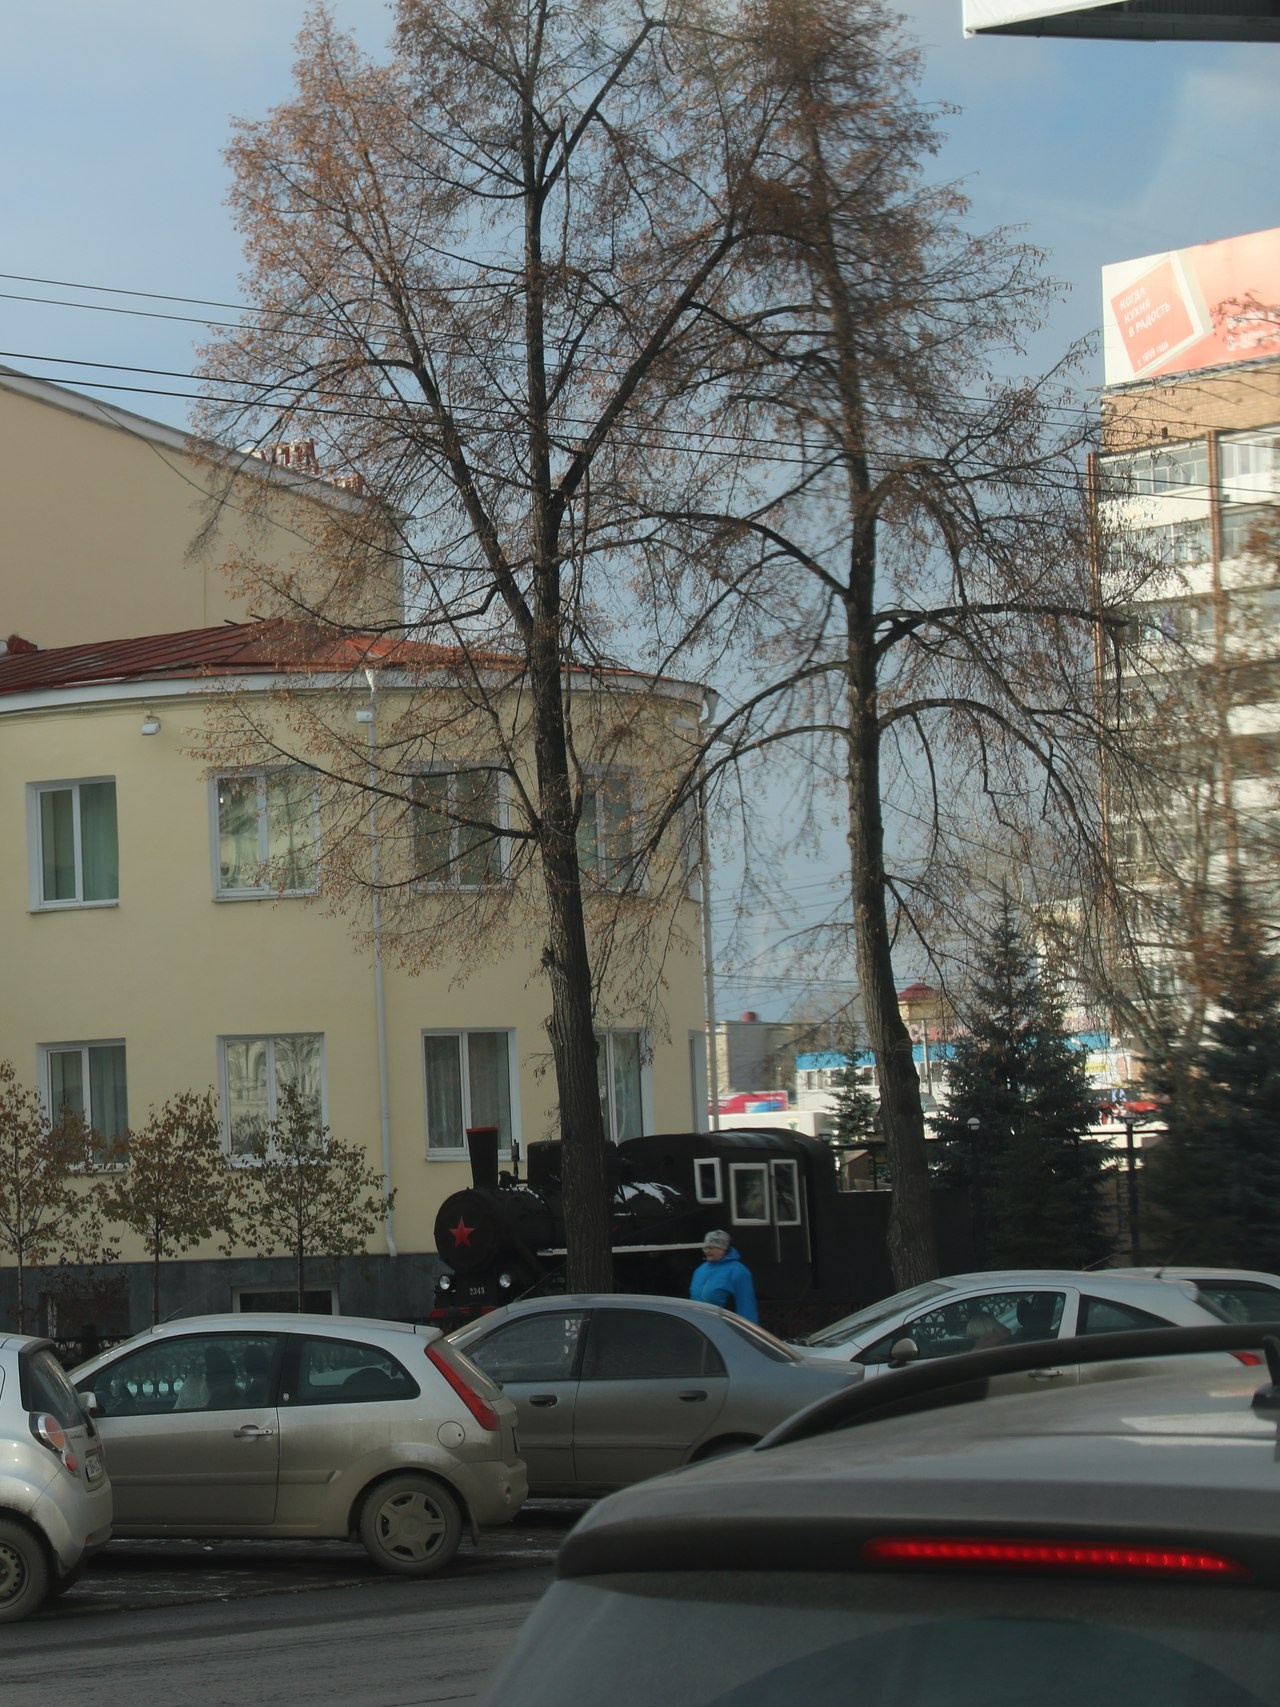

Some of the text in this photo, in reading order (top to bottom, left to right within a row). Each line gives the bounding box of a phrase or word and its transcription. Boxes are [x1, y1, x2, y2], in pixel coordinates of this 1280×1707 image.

[1119, 286, 1146, 311] КОГДА
[1124, 298, 1151, 324] КУХНЯ
[1128, 303, 1171, 337] В РАДОСТЬ
